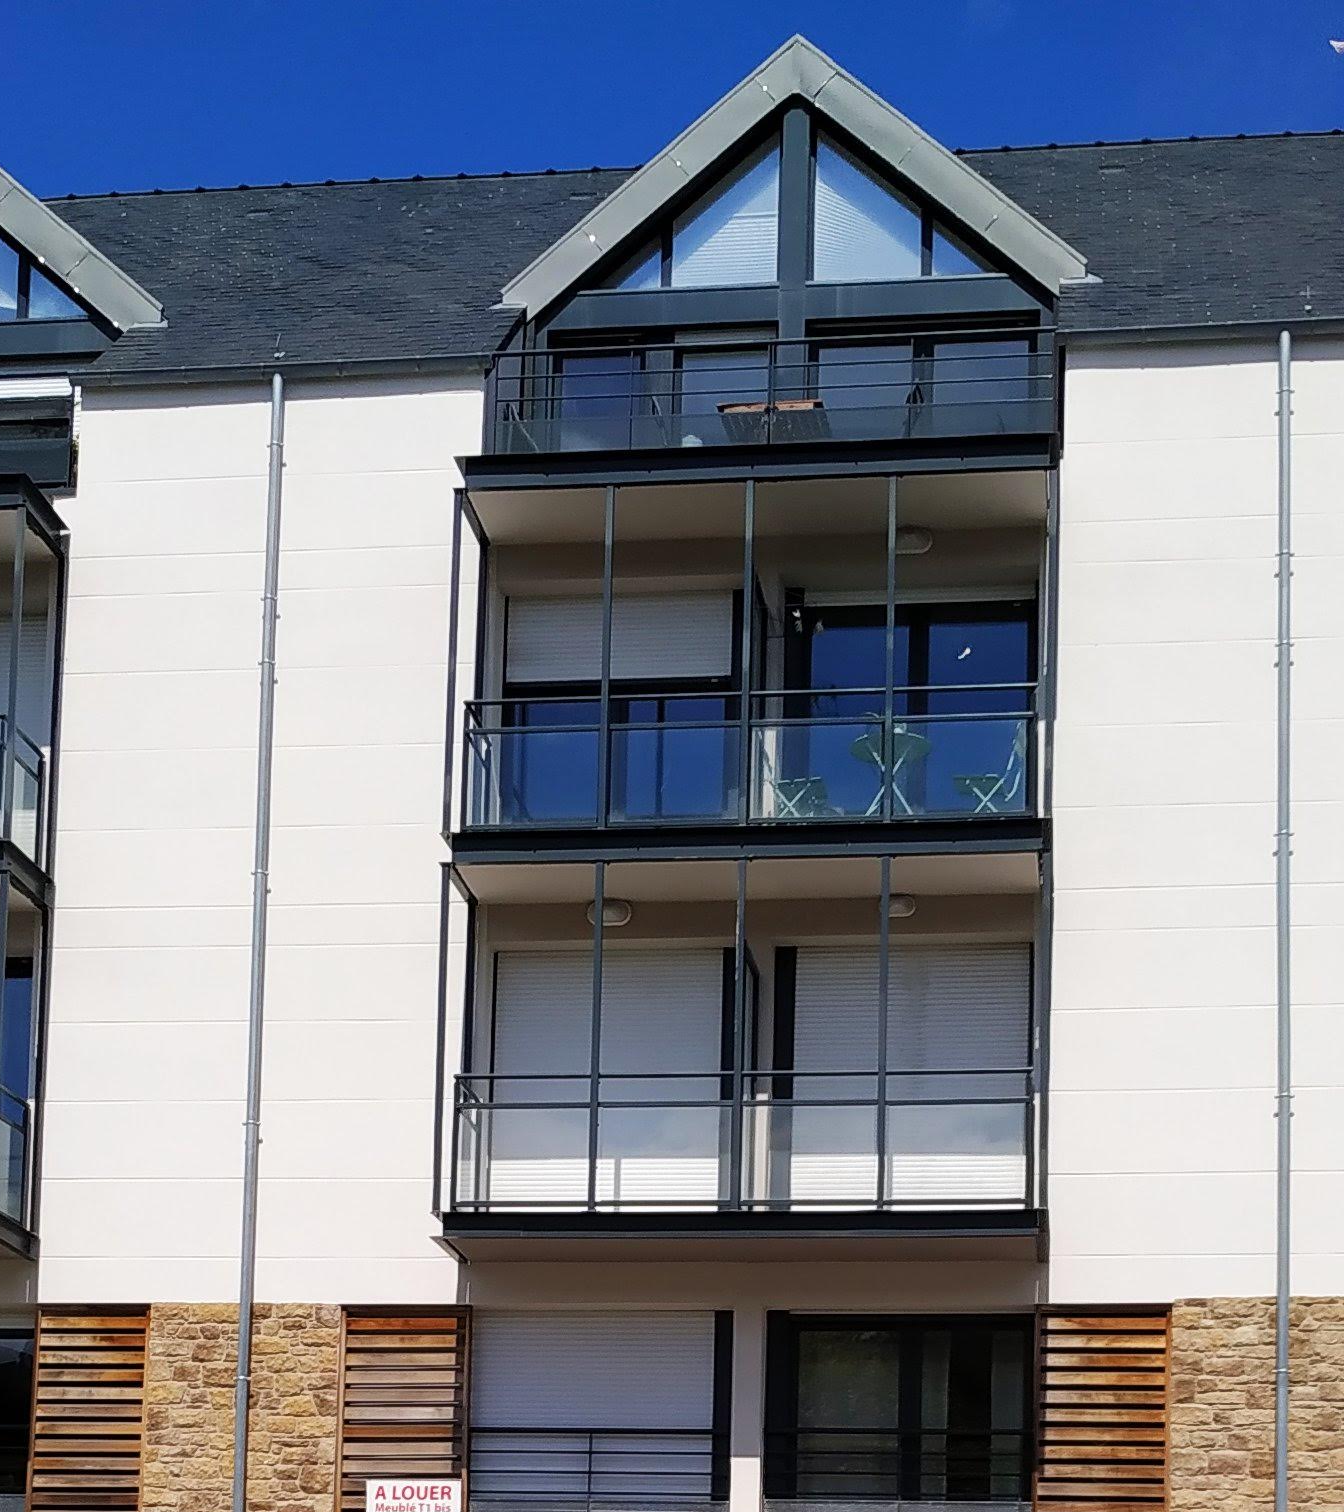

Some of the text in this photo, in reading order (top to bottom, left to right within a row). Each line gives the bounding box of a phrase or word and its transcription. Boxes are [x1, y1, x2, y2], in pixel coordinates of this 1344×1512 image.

[374, 1485, 452, 1501] A LOUER
[375, 1502, 452, 1512] Meublé T1 bis
